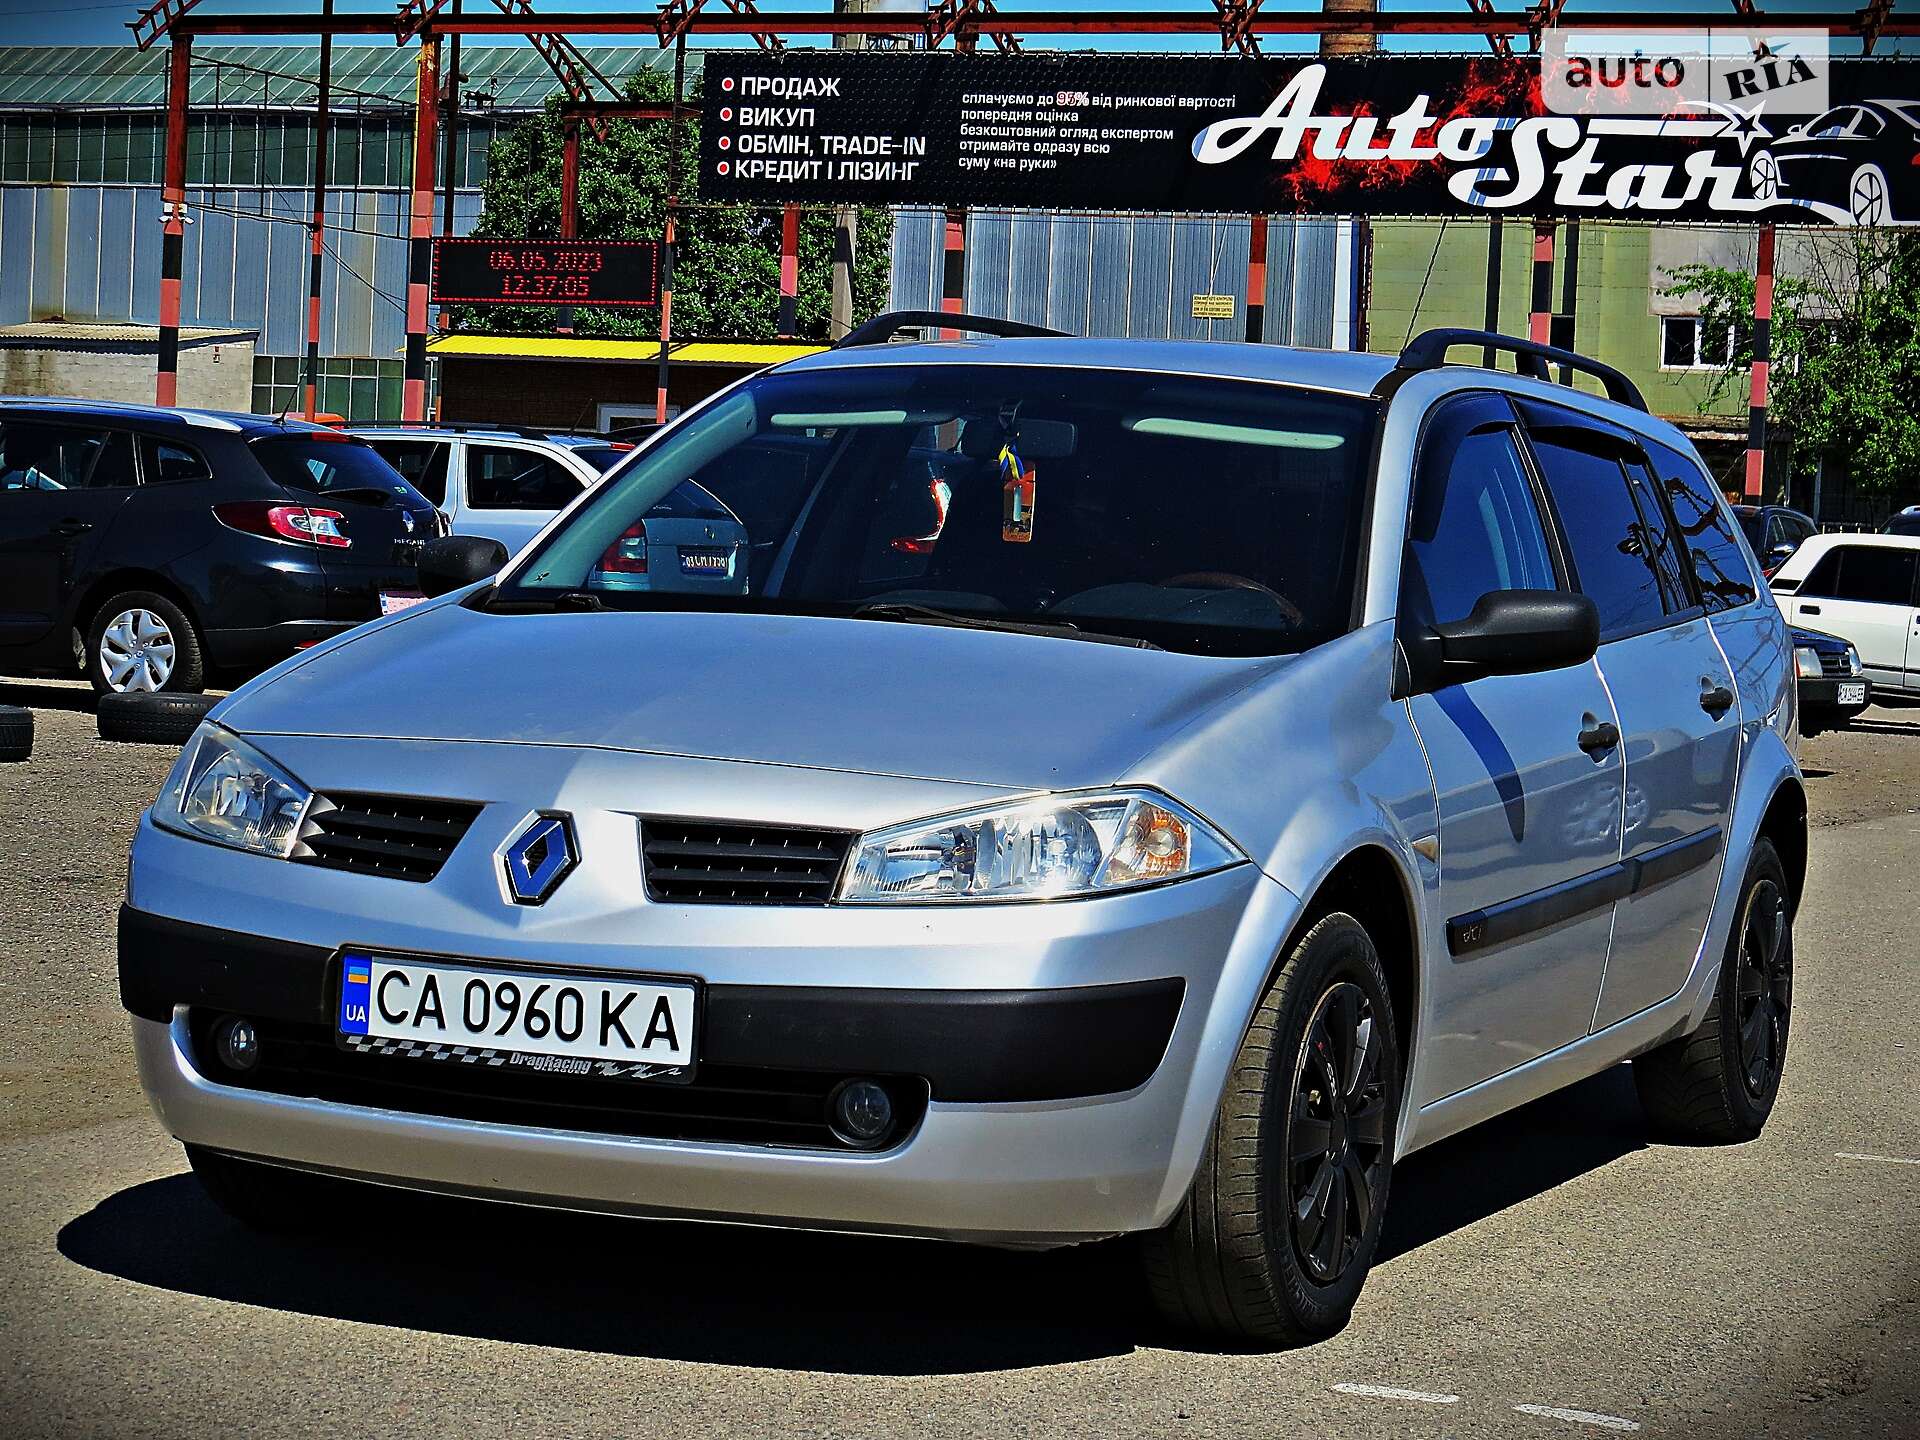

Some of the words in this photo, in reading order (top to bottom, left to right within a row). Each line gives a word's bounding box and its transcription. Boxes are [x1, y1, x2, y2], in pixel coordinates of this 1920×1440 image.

[740, 77, 841, 99] ПРОДАЖ
[962, 94, 1034, 107] сплачуємо
[1036, 96, 1054, 106] до
[1056, 91, 1090, 106] 95%
[1092, 93, 1112, 108] від
[1115, 95, 1176, 109] ринкової
[1178, 95, 1236, 110] вартості
[739, 107, 815, 127] ВИКУП
[961, 110, 1032, 123] попередня
[1035, 109, 1079, 123] оцінка
[960, 123, 1056, 136] безкоштовний
[1059, 127, 1098, 140] огляд
[1101, 128, 1174, 142] експертом
[738, 134, 814, 157] ОБМІН,
[820, 135, 926, 155] TRADE-IN
[959, 140, 1030, 153] отримайте
[1033, 142, 1081, 156] одразу
[1083, 143, 1111, 153] всю
[735, 159, 822, 182] КРЕДИТ
[828, 161, 832, 180] І
[838, 162, 919, 181] ЛІЗИНГ
[958, 157, 990, 170] суму
[993, 158, 1016, 168] «на
[1019, 159, 1057, 171] руки»
[501, 274, 590, 296] 12:37:05
[346, 1004, 366, 1023] UA
[376, 970, 446, 1031] CA
[463, 977, 584, 1042] 0960
[599, 990, 680, 1052] KA
[510, 1052, 592, 1075] DragRacing
